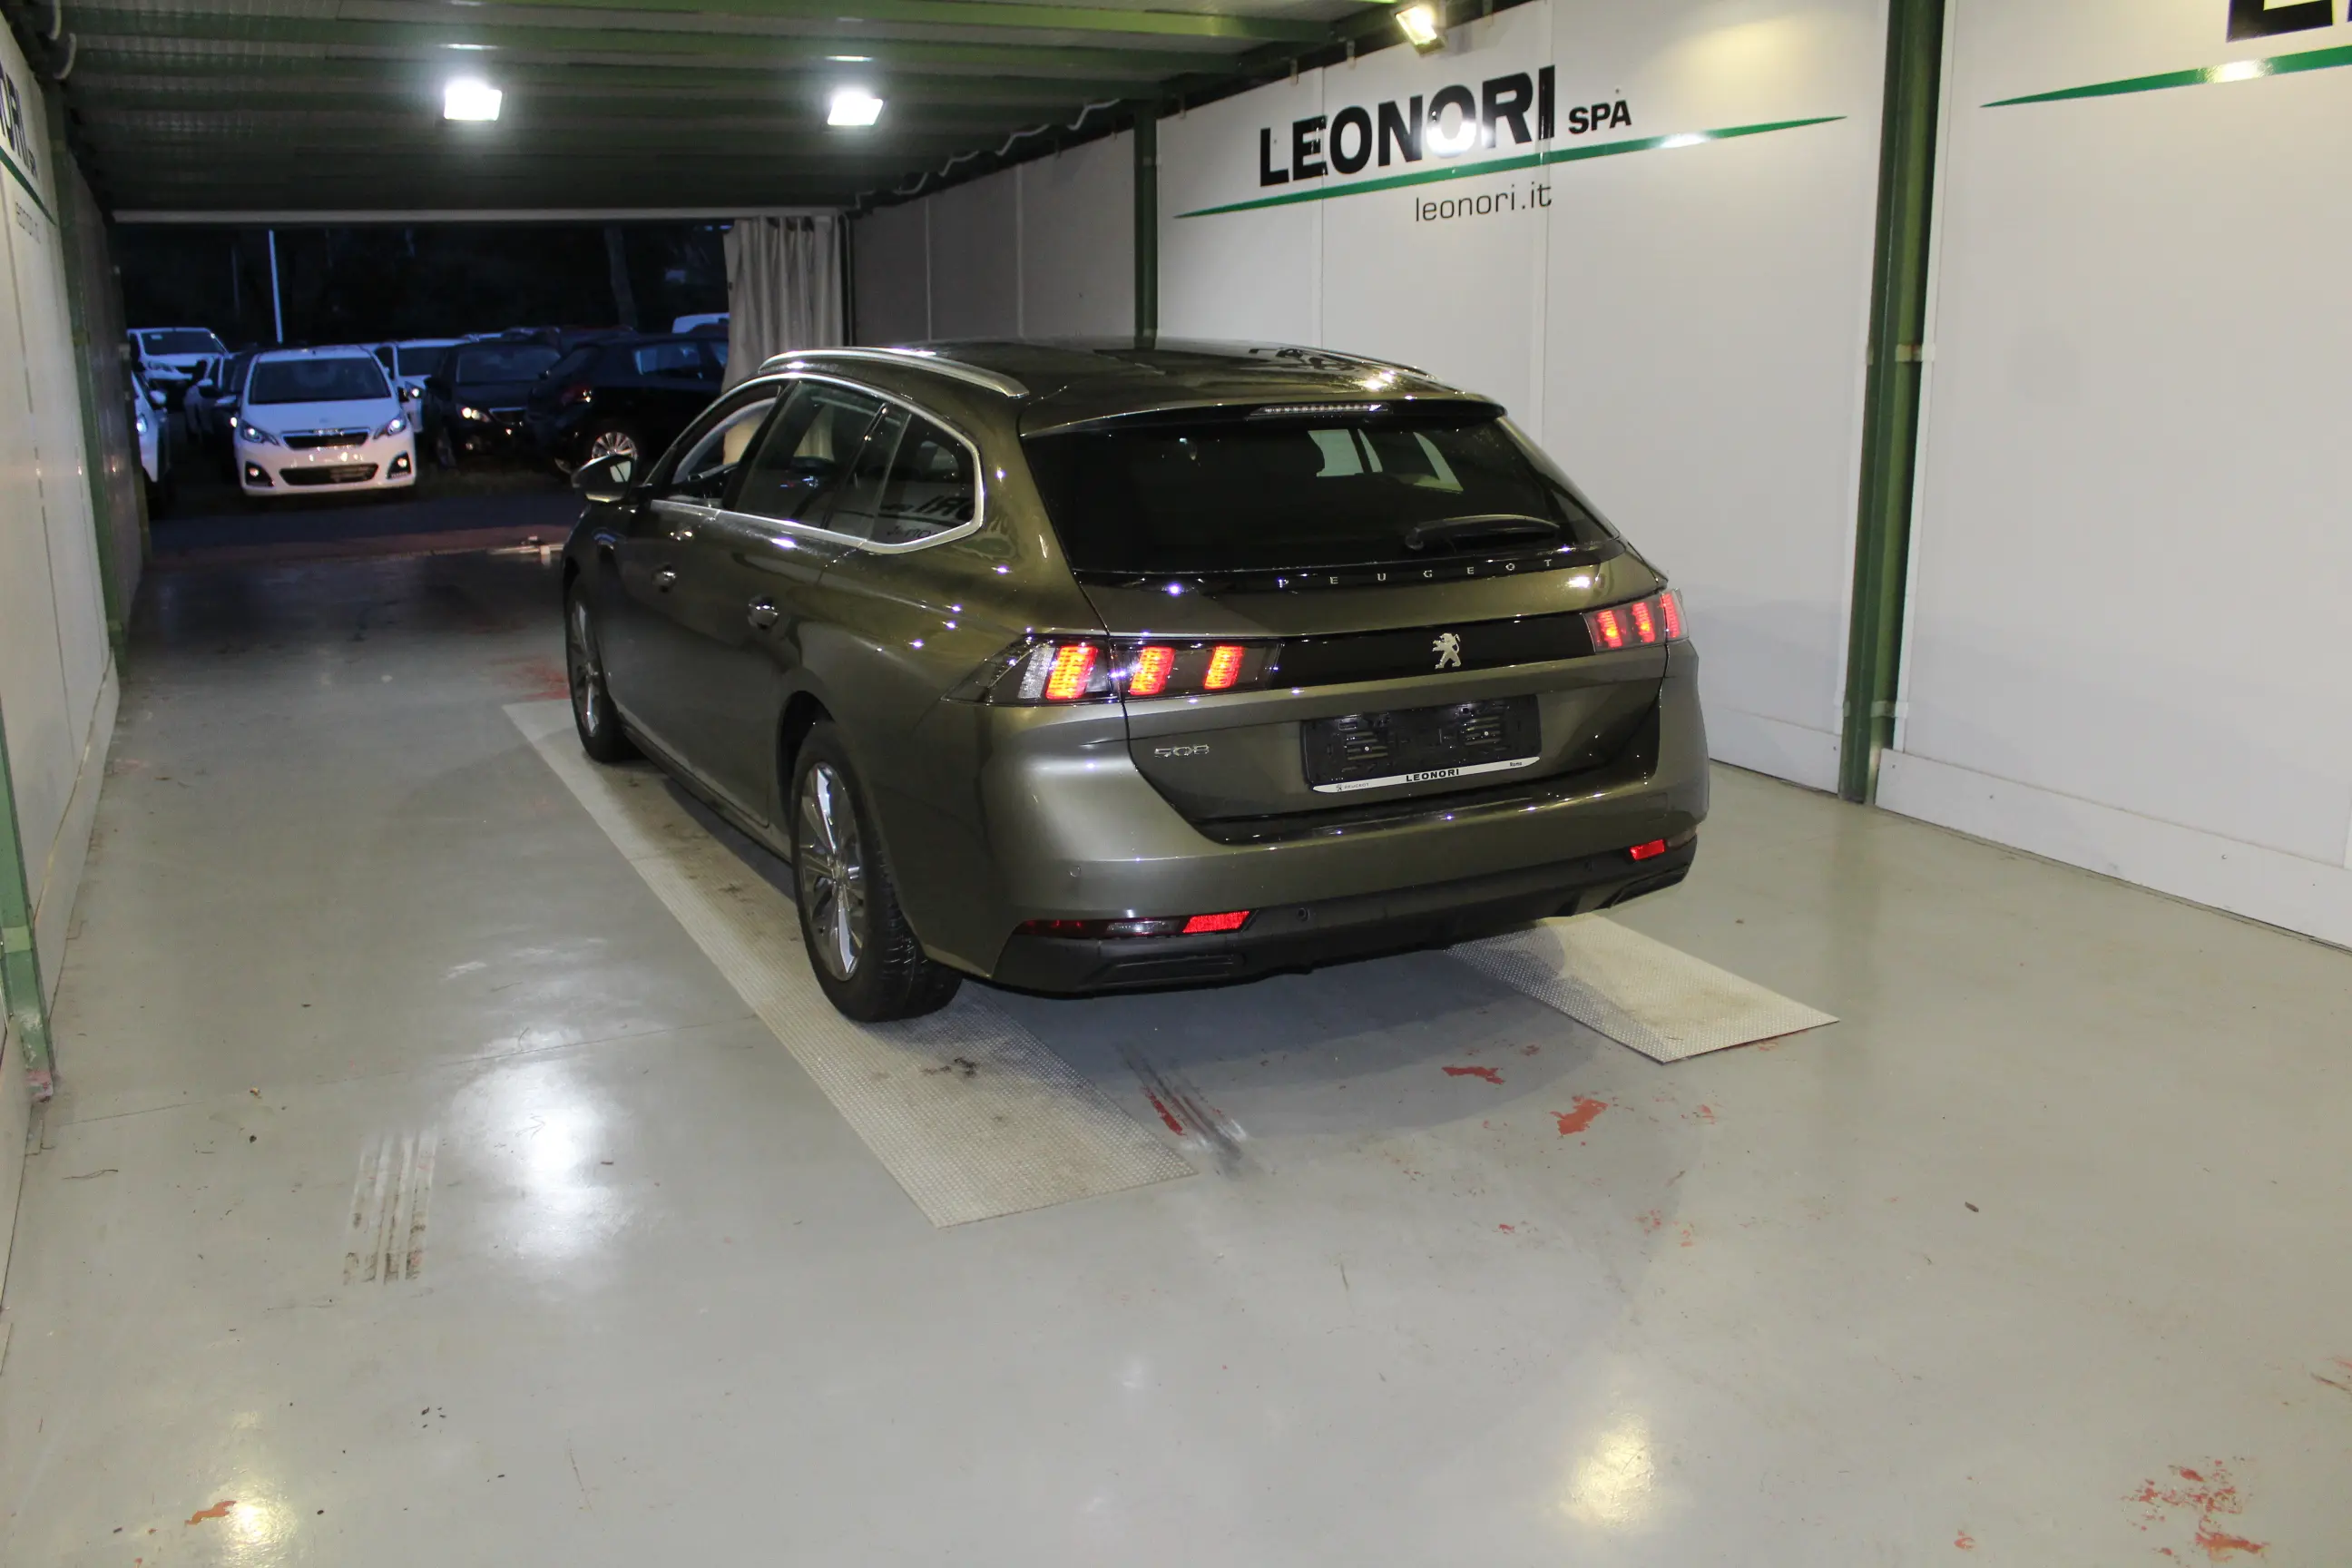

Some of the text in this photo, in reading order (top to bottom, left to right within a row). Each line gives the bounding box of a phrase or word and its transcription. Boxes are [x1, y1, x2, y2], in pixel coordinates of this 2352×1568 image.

[1259, 65, 1632, 186] LEONORI SPA
[1416, 181, 1552, 221] leonori.it
[1278, 559, 1553, 588] PEUGEOT
[1153, 744, 1210, 758] 508
[1406, 769, 1459, 782] LEONORI
